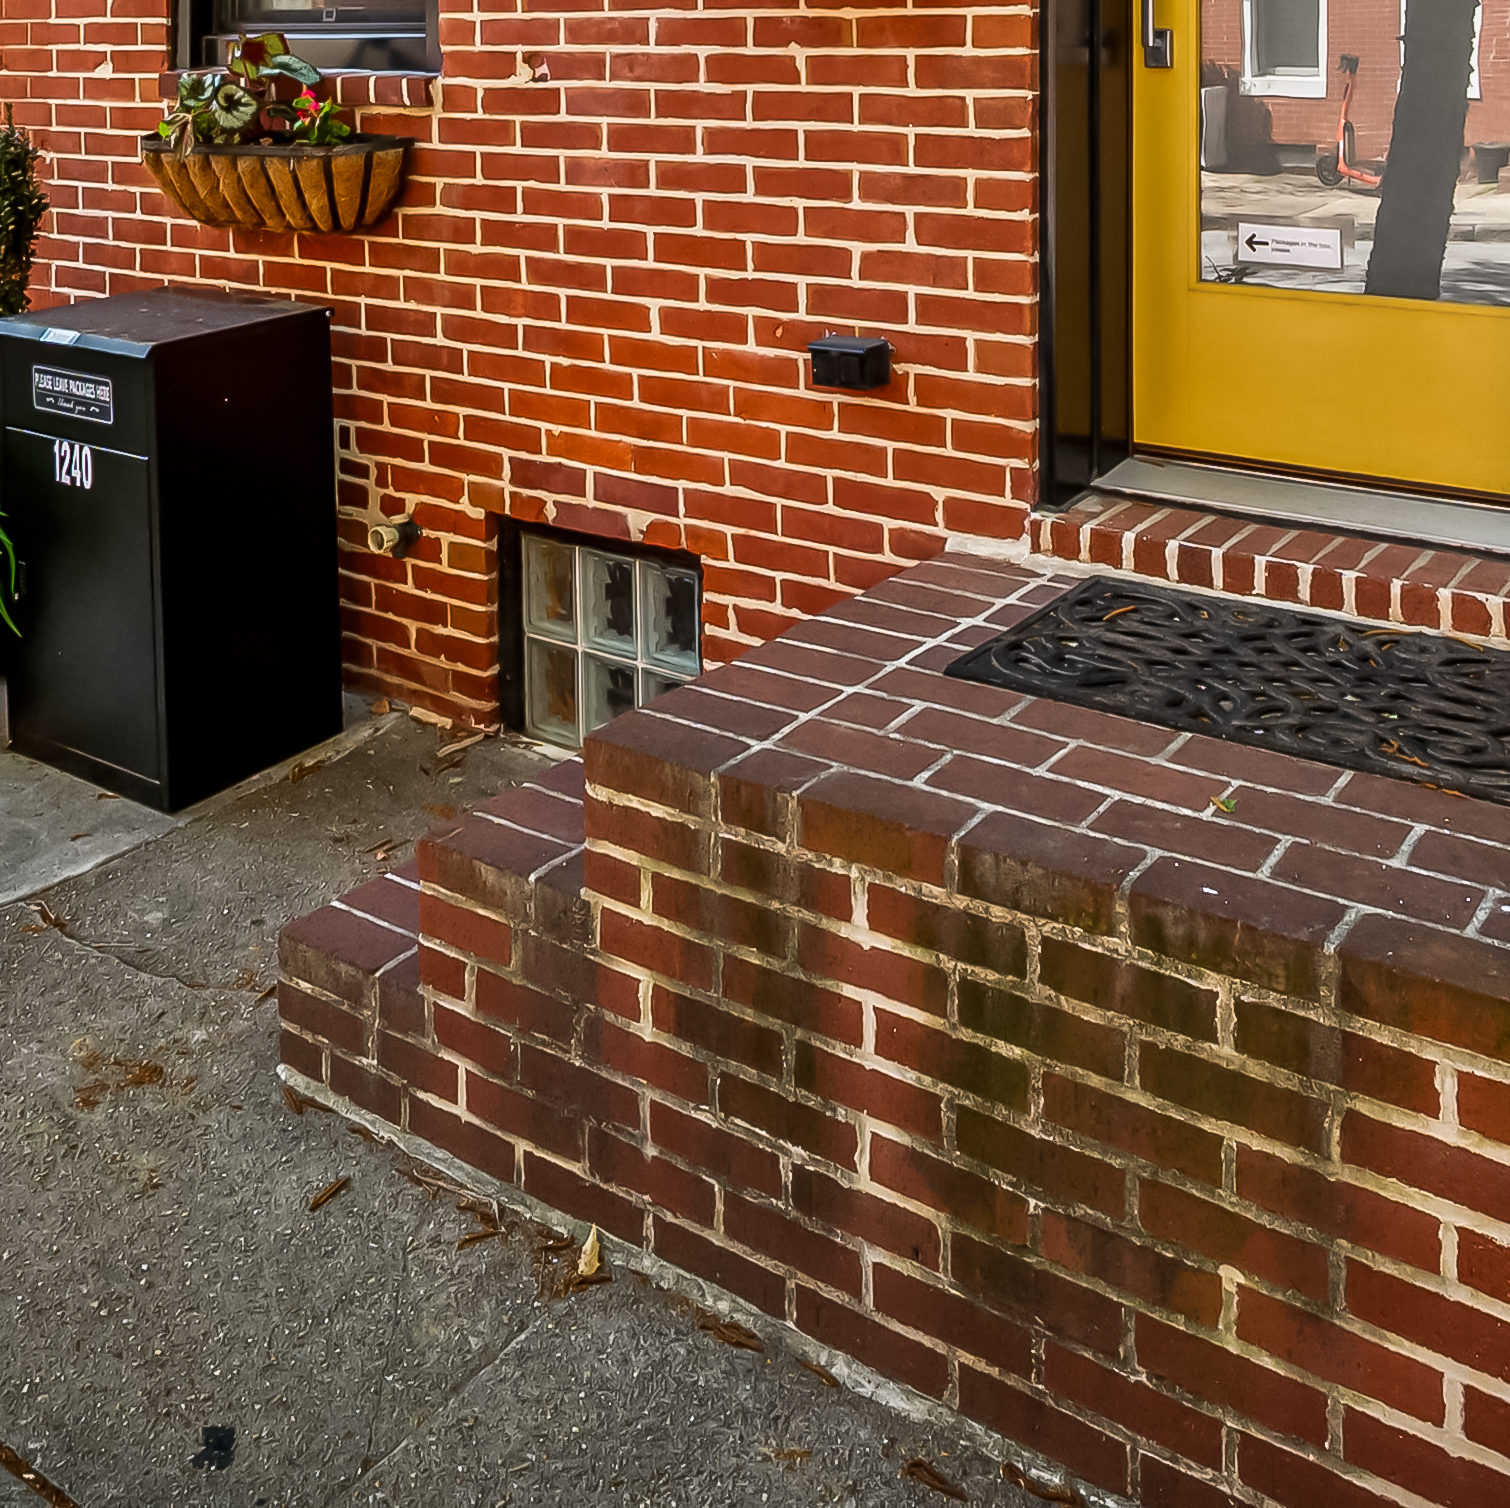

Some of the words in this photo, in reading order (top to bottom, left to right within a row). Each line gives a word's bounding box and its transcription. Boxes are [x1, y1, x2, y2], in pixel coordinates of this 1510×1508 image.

[34, 373, 53, 390] PLEASE
[53, 376, 69, 393] LEAVE
[69, 379, 96, 399] PACKAGES
[53, 439, 93, 490] 1240
